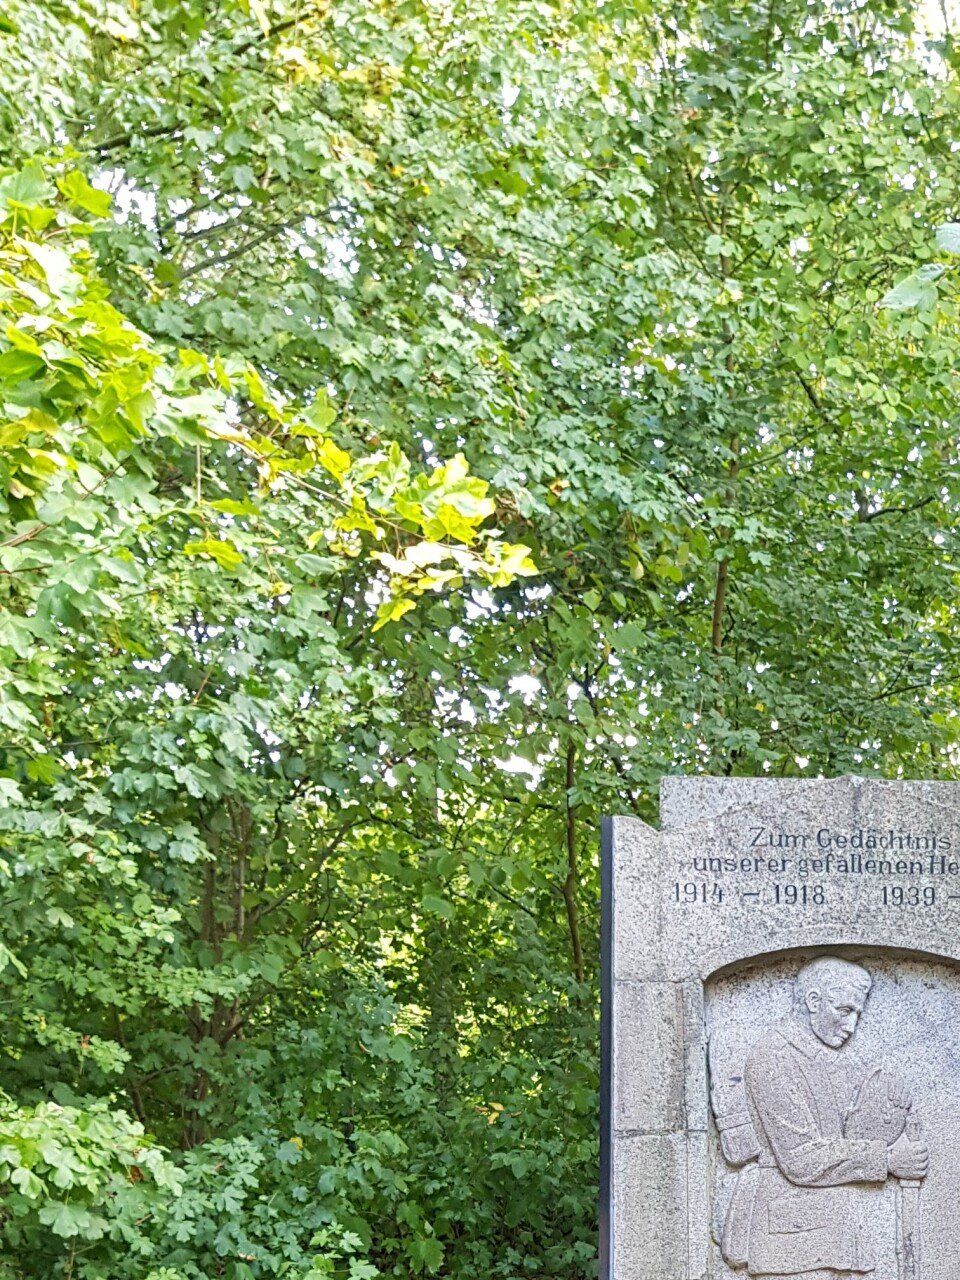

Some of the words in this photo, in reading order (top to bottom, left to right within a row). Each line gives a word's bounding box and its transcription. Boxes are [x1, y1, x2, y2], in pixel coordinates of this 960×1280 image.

[749, 827, 807, 848] Zum
[816, 828, 951, 850] Gedächtnis
[692, 857, 792, 873] unserer
[798, 854, 923, 877] gefallenen
[674, 882, 724, 903] 1914
[773, 883, 825, 905] 1918
[881, 886, 936, 906] 1939
